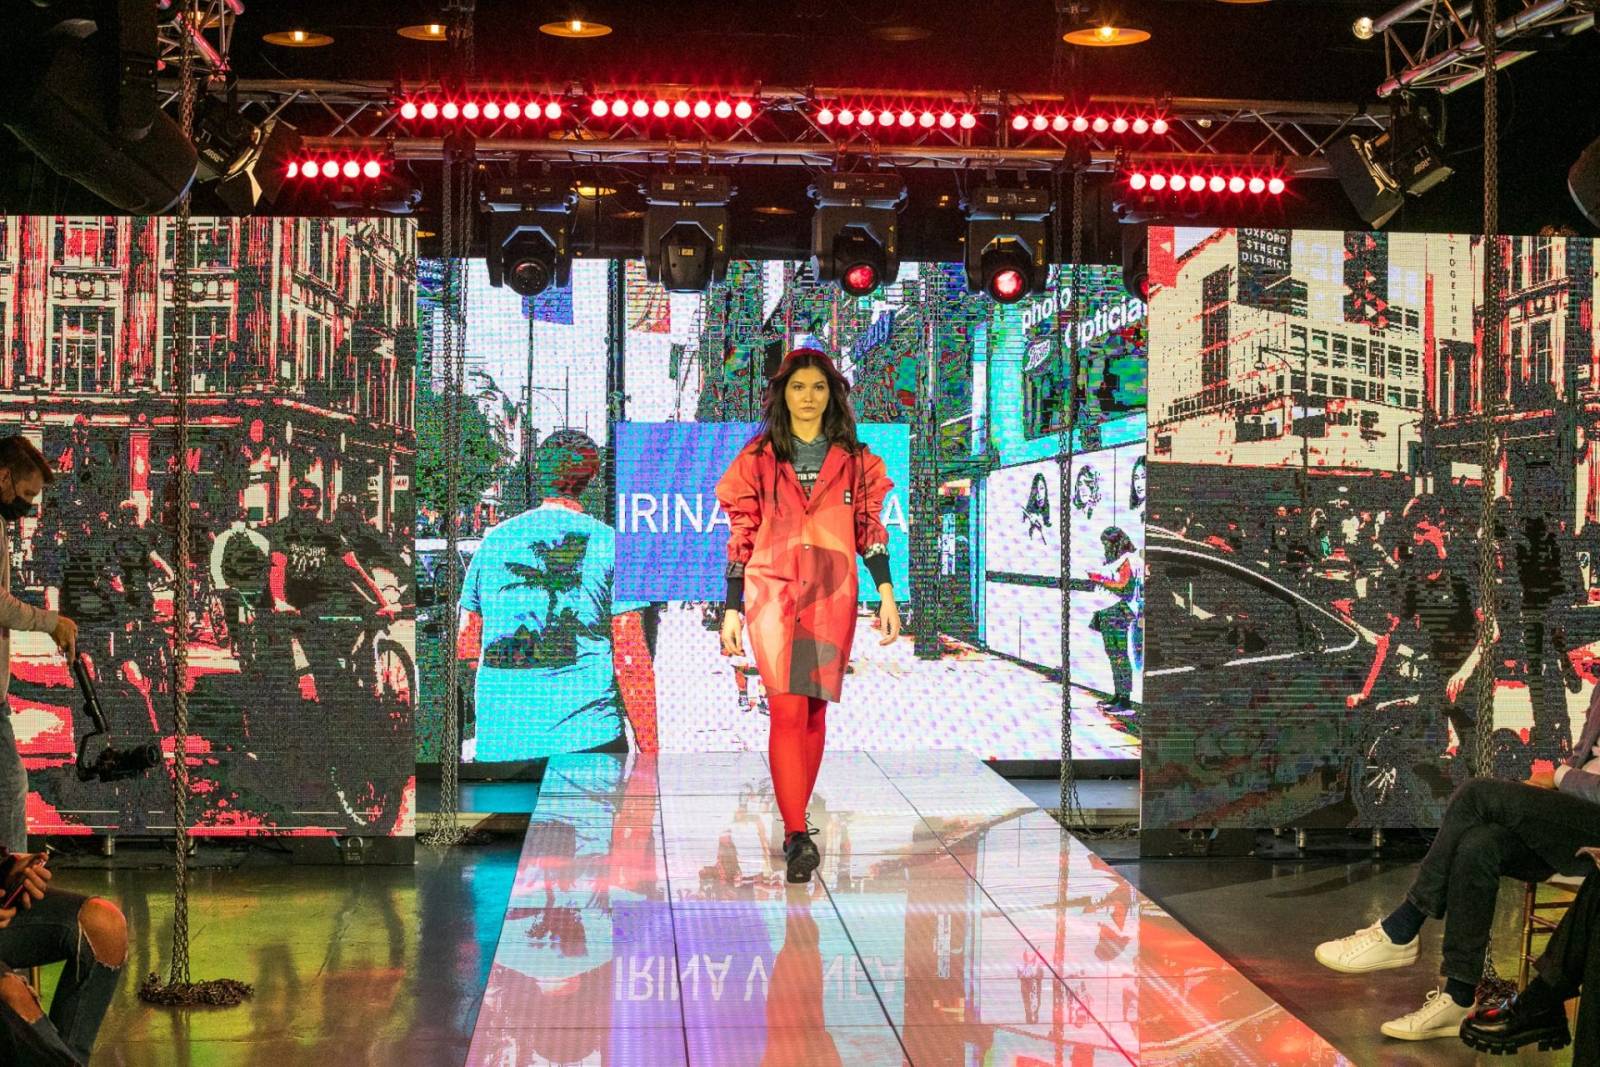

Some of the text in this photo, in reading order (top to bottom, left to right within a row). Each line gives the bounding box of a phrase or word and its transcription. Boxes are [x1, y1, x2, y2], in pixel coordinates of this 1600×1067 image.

[1244, 228, 1287, 245] OXFORD
[1241, 251, 1288, 270] DISTRICT
[1022, 287, 1072, 336] photo
[1449, 246, 1457, 337] TOGETHER
[619, 493, 732, 533] IRINA
